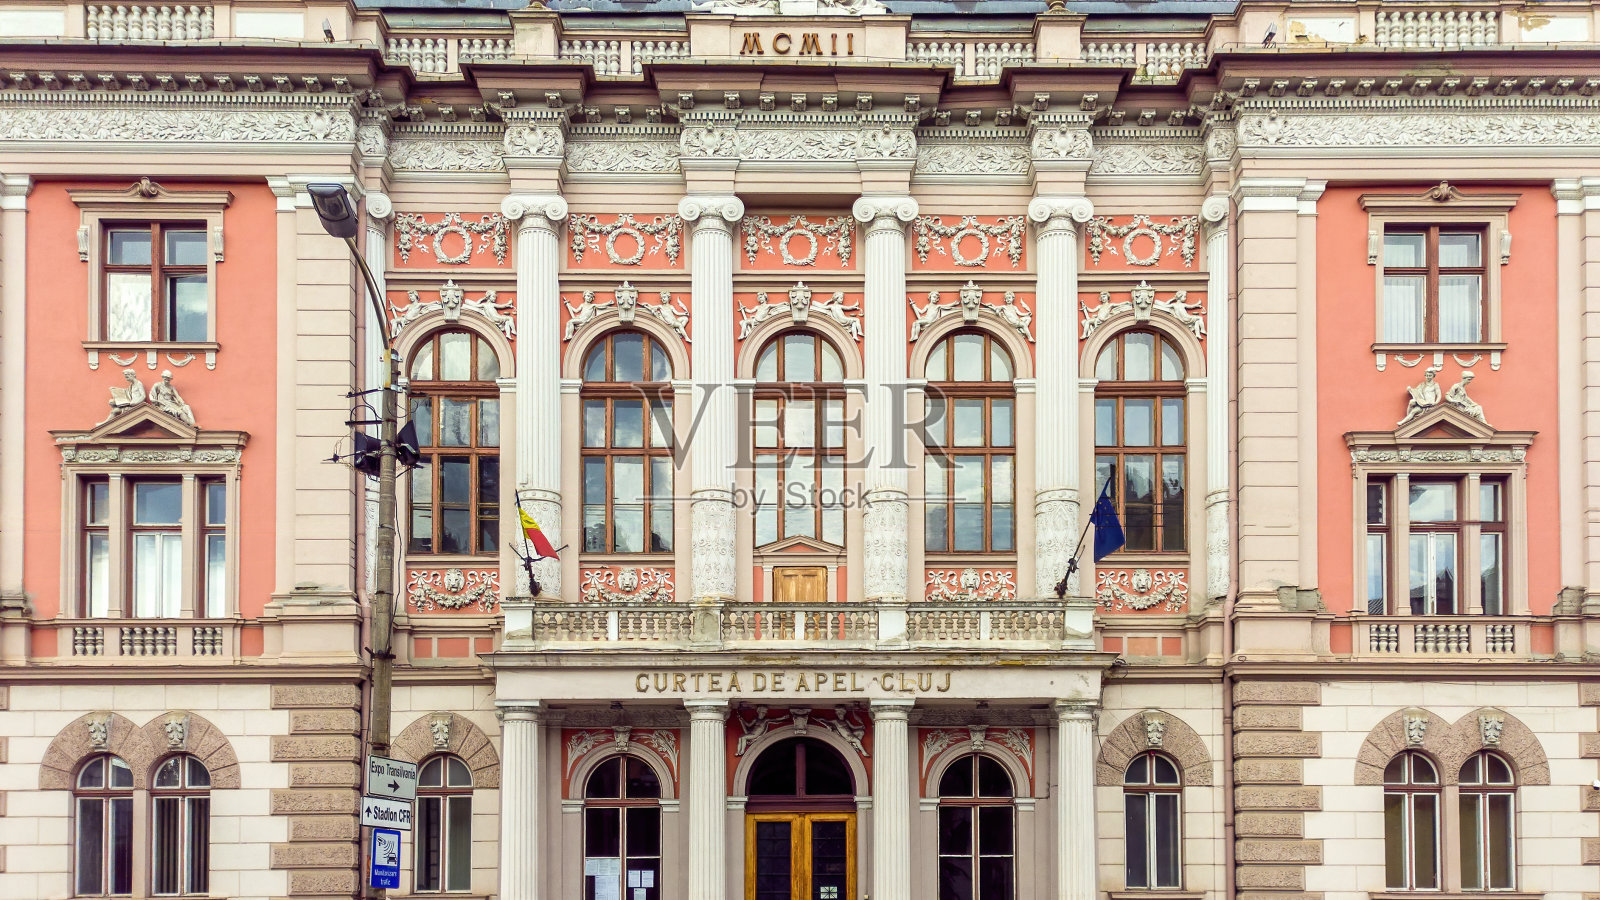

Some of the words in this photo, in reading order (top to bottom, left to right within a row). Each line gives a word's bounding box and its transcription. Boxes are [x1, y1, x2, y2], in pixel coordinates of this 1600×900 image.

[740, 32, 854, 55] MCMII
[635, 672, 742, 693] CURTEA
[752, 672, 785, 692] DE
[795, 672, 864, 692] APEL
[880, 672, 951, 692] CLUJ
[371, 761, 385, 777] Expo
[386, 763, 415, 779] Transilvania
[373, 805, 398, 821] Stadion
[398, 809, 411, 823] CFR
